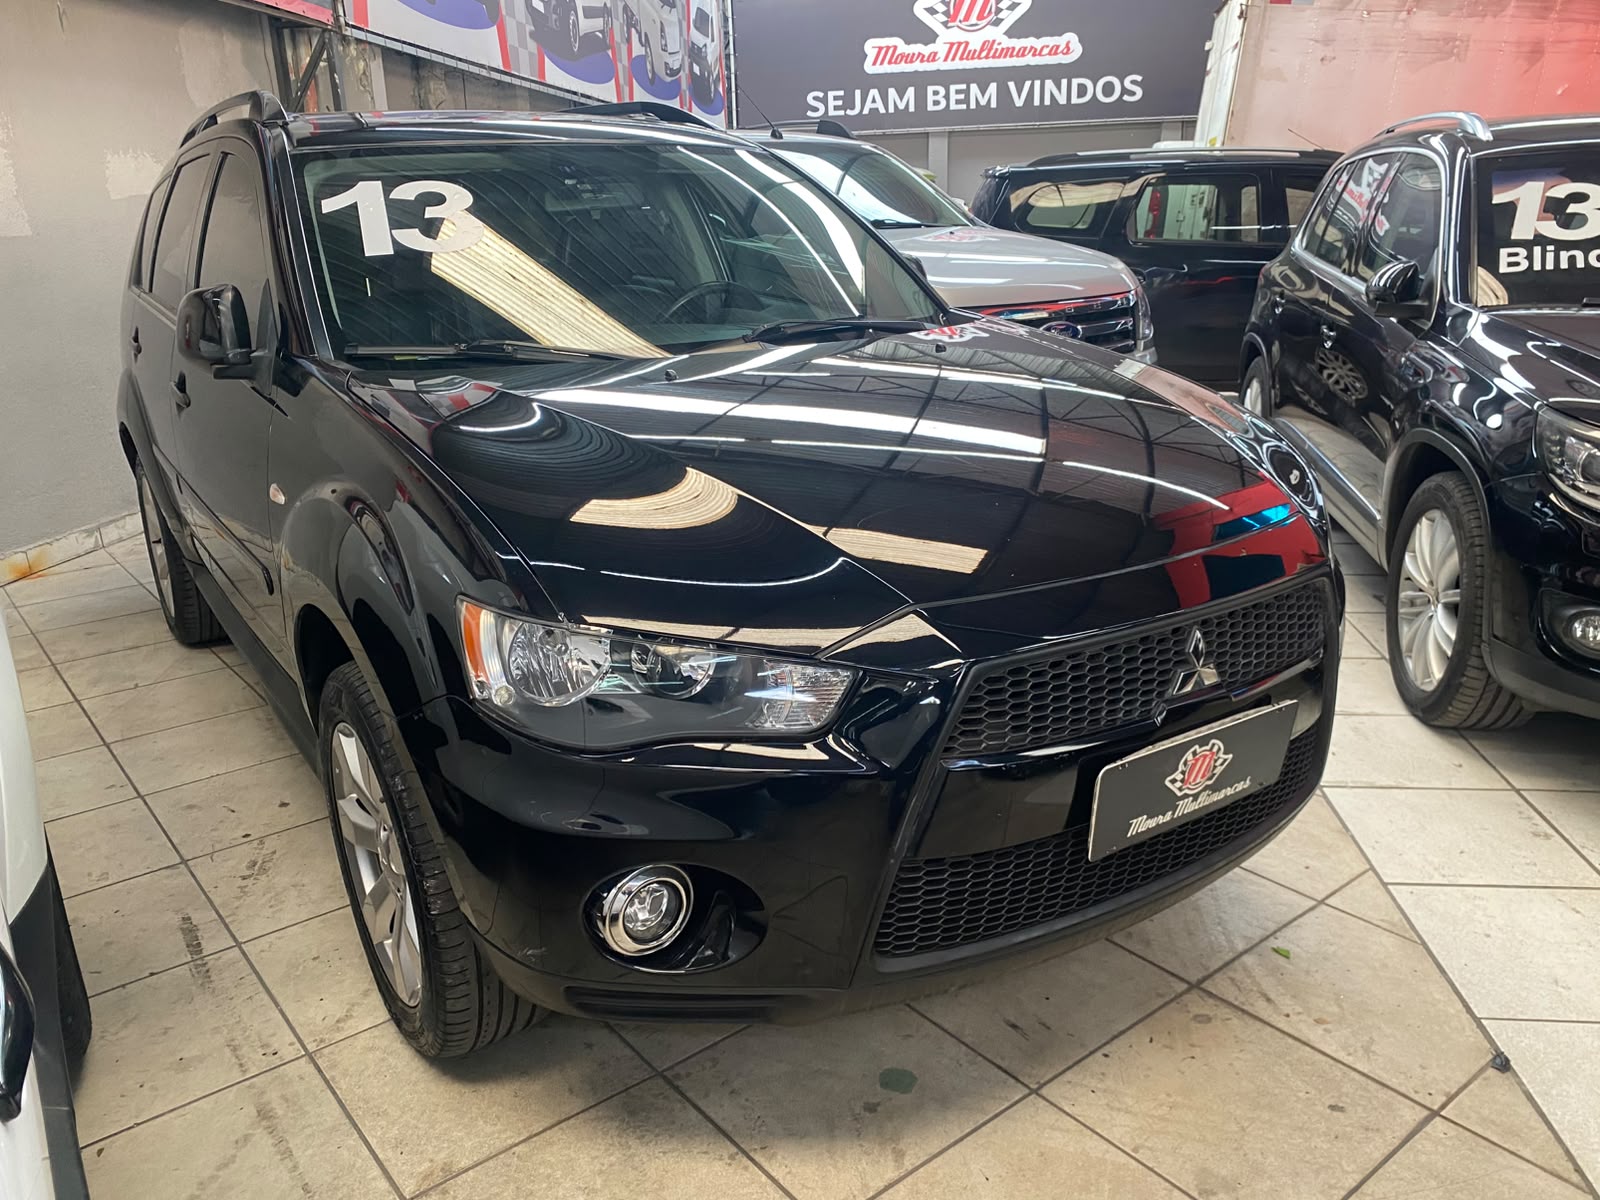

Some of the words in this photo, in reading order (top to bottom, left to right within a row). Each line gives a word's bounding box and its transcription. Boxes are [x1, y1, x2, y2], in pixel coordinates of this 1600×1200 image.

[871, 44, 941, 67] Moura
[942, 39, 1075, 63] Multimarcas
[805, 86, 915, 118] SEJAM
[926, 82, 998, 112] BEM
[1007, 74, 1144, 107] VINDOS
[321, 180, 484, 257] 13
[1491, 181, 1600, 241] 13
[1126, 810, 1173, 838] Moura
[1173, 776, 1251, 818] Multimarcas
